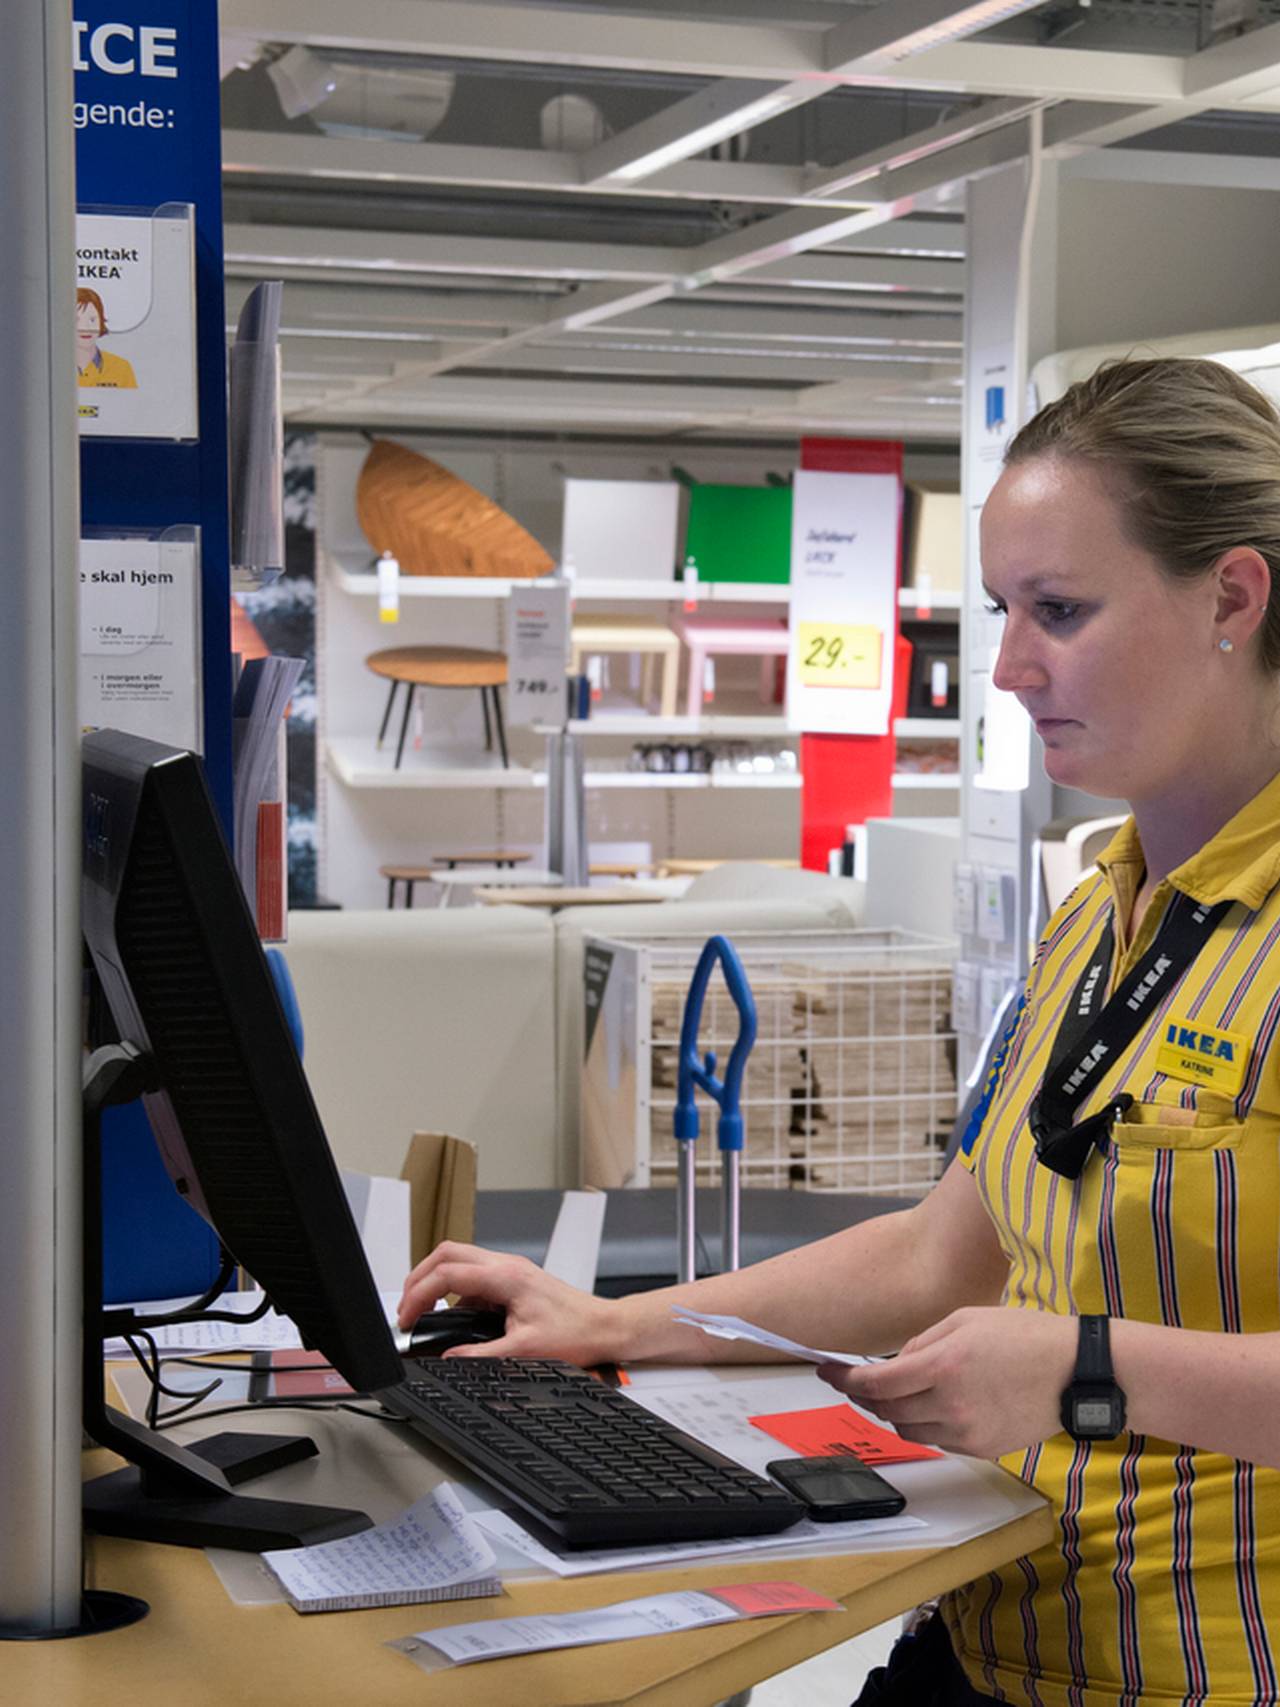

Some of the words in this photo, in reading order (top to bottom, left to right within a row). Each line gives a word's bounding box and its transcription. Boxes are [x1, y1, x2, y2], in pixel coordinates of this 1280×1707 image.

[73, 101, 175, 129] gende:
[78, 265, 121, 279] IKEA
[91, 570, 125, 583] skal
[131, 570, 174, 587] hjem
[1126, 953, 1173, 1011] IKEA
[1166, 1024, 1235, 1062] IKEA
[1061, 1040, 1110, 1096] IKEA
[1181, 1059, 1214, 1077] KATRINE
